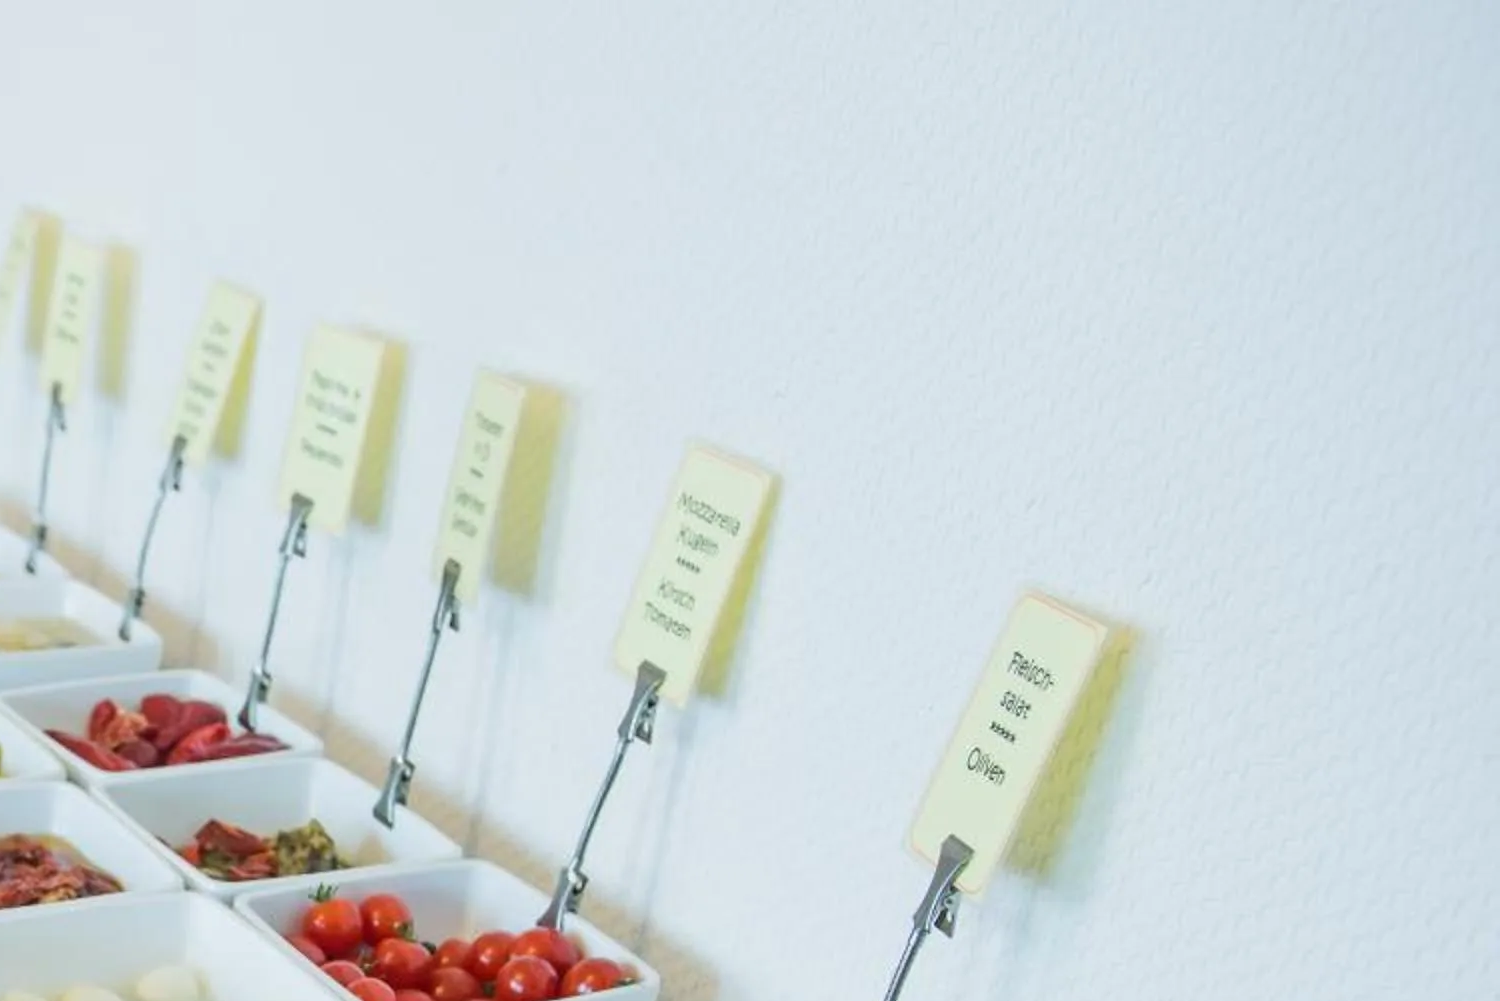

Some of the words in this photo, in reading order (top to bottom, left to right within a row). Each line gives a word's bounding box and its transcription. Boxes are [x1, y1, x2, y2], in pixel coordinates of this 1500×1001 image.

[677, 492, 742, 537] Mozzarella
[644, 601, 693, 640] Tomaten
[1007, 650, 1055, 691] Fleisch-
[999, 689, 1032, 720] salat
[967, 746, 1007, 786] Oliven
